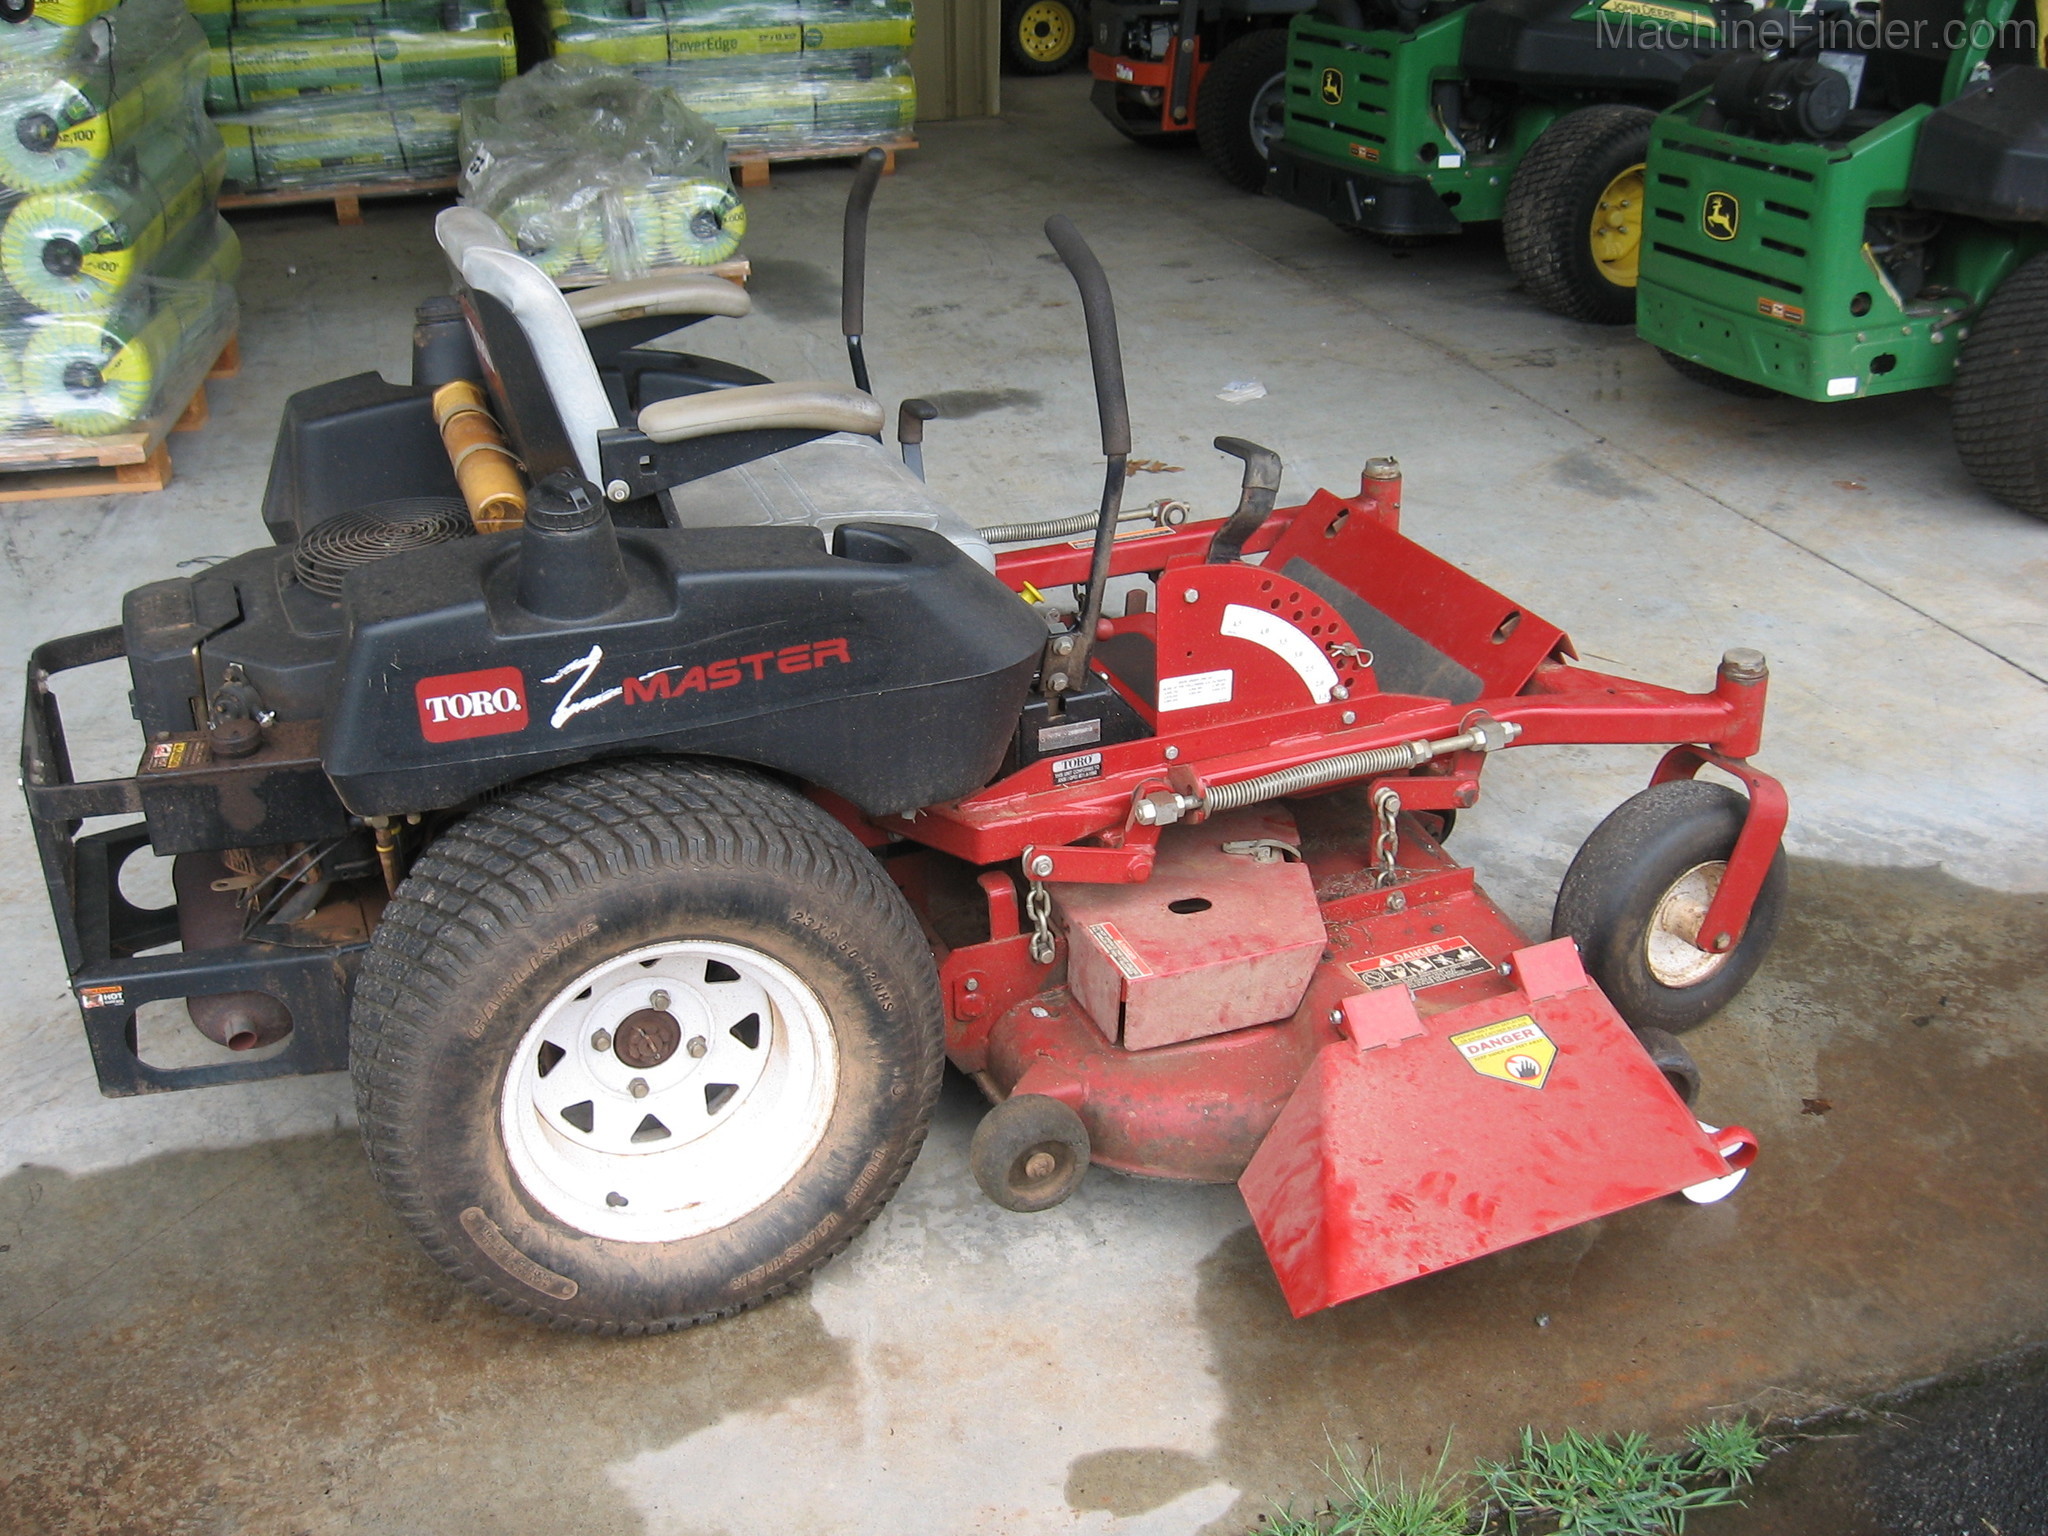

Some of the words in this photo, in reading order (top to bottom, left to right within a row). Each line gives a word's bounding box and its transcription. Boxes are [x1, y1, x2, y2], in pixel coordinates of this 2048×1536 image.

[1614, 2, 1640, 14] JOHN
[1642, 4, 1675, 20] DEERE
[540, 644, 623, 729] Z
[622, 637, 851, 706] MASTER
[1062, 755, 1093, 770] TORO
[1393, 944, 1444, 962] DANGER
[467, 917, 599, 1040] CARLISLE
[103, 992, 123, 1000] HOT
[1466, 1028, 1535, 1054] DANGER
[728, 1212, 840, 1290] MASTER
